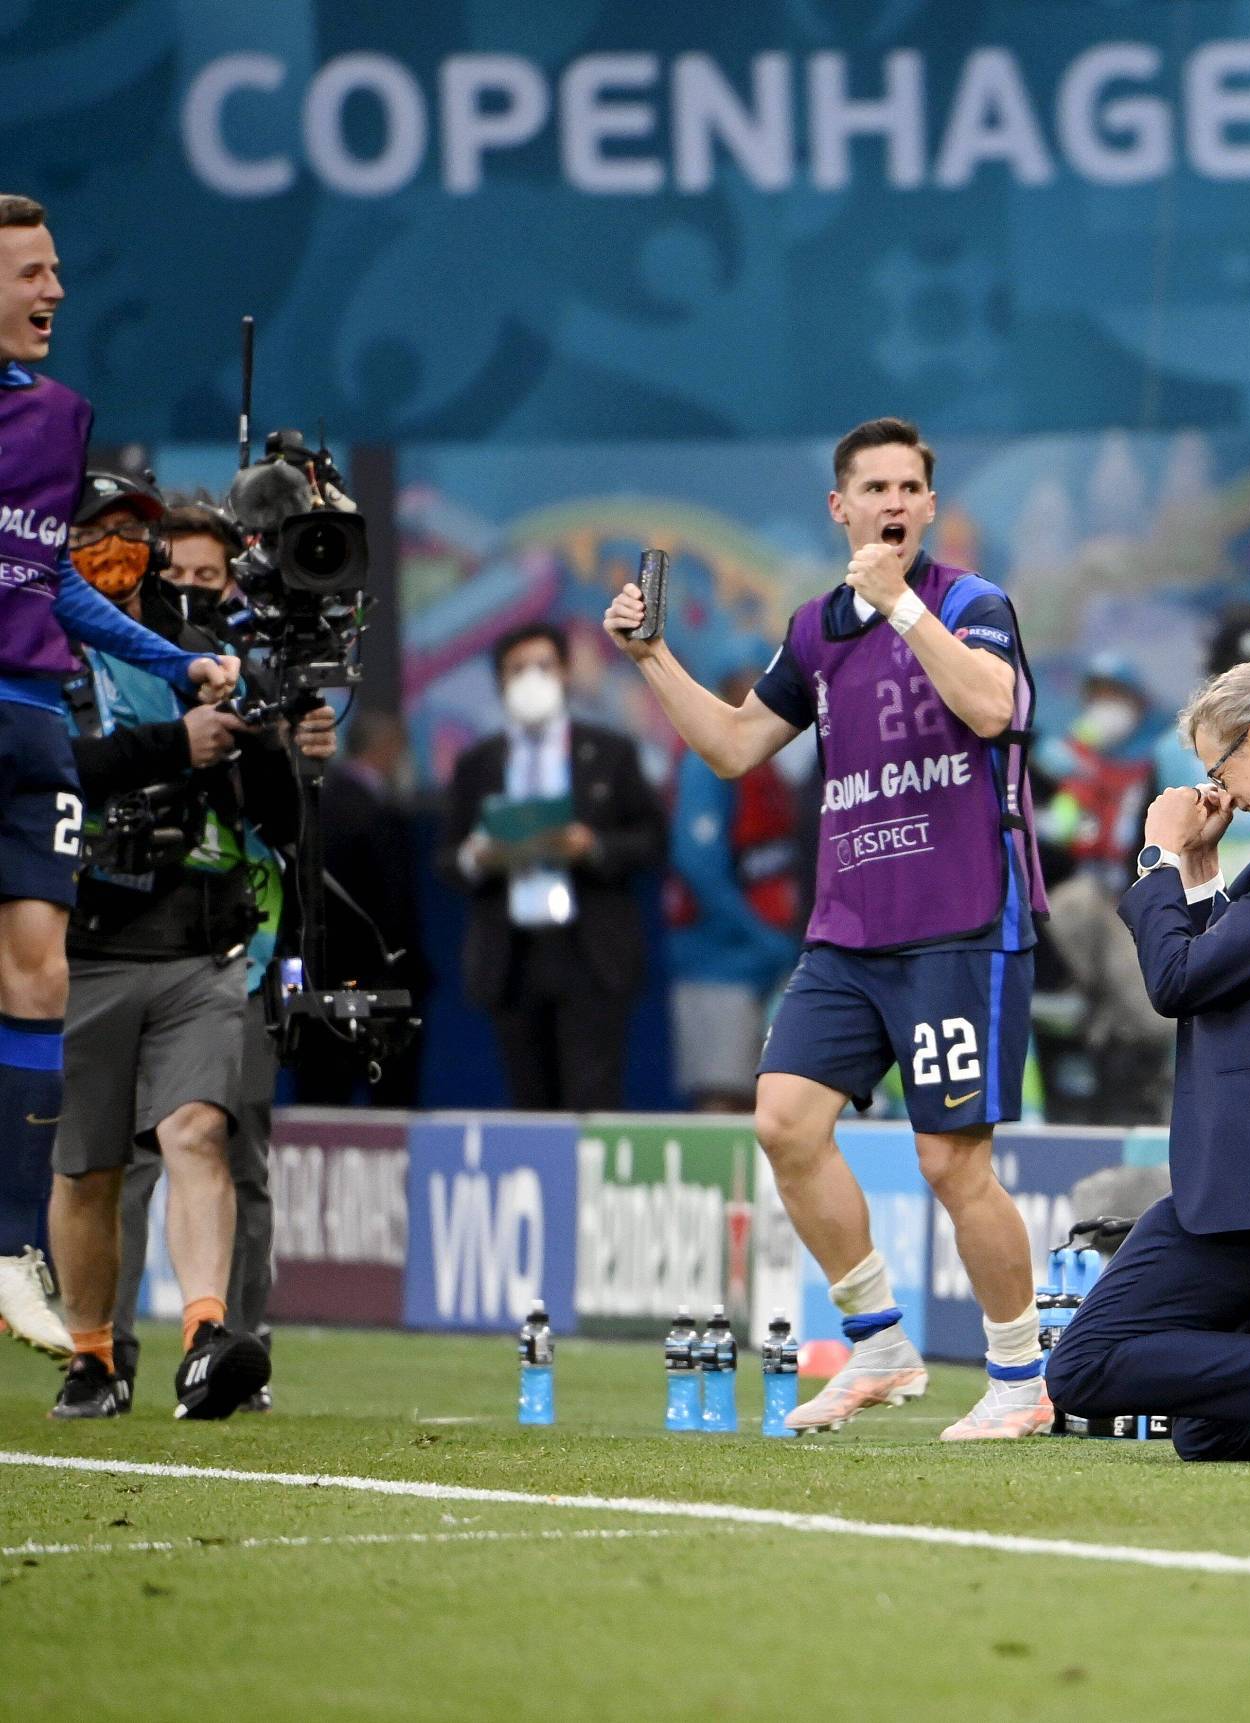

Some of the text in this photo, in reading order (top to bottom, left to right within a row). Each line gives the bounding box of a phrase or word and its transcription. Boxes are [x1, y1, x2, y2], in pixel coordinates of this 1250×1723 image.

[968, 628, 1009, 644] RESPECT
[821, 752, 972, 814] QUAL GAME
[912, 1017, 981, 1085] 22
[429, 1117, 545, 1330] vivo
